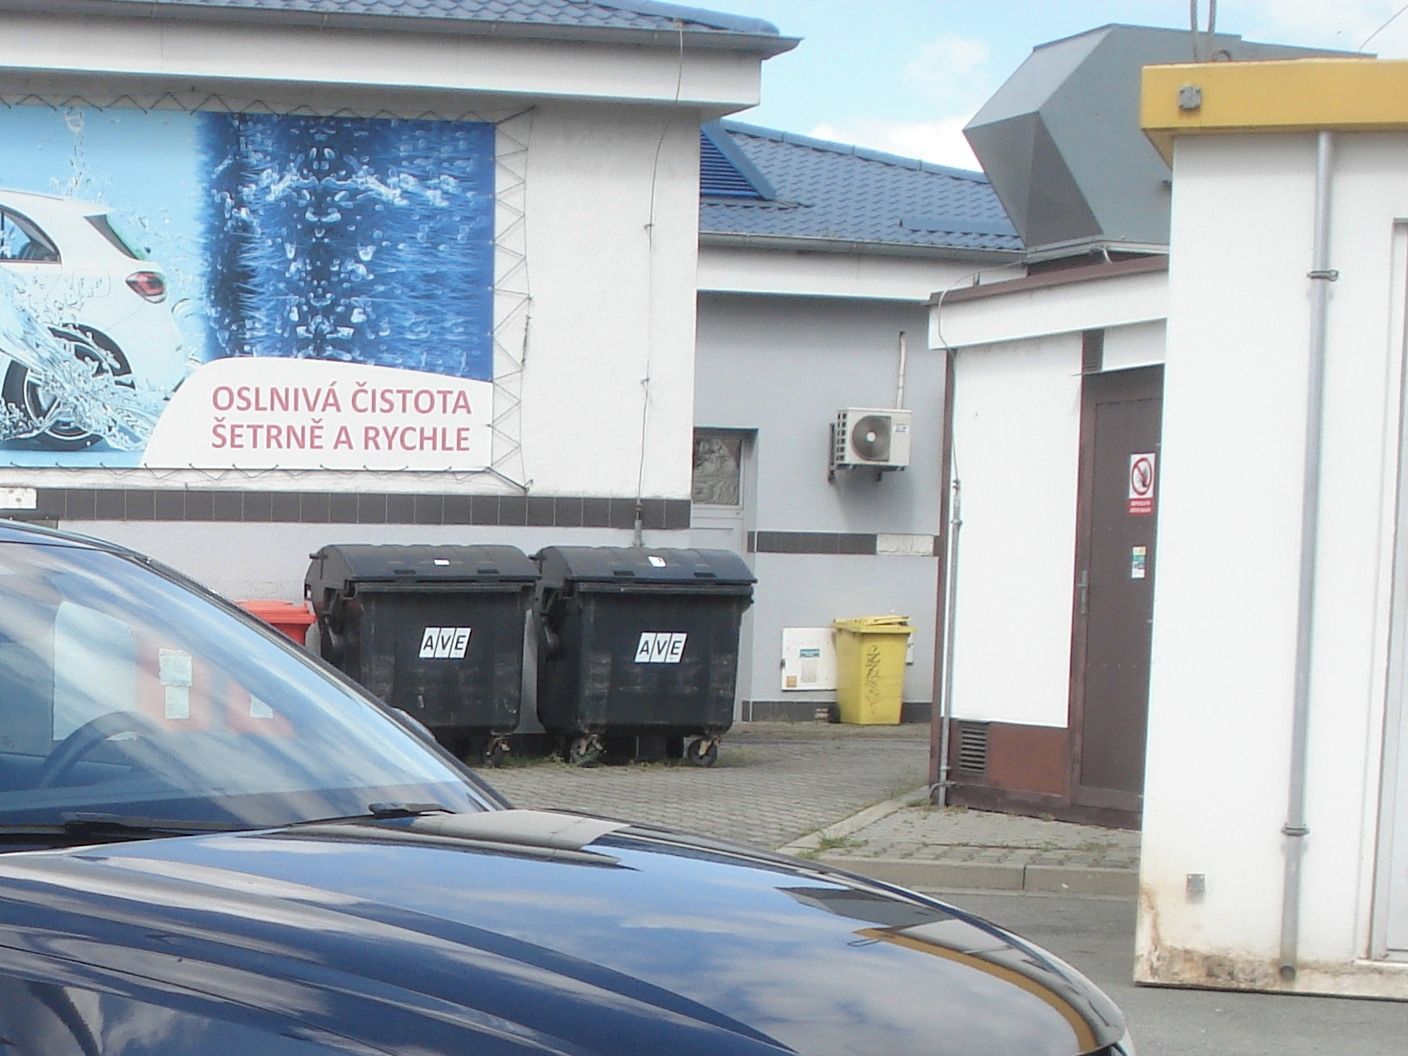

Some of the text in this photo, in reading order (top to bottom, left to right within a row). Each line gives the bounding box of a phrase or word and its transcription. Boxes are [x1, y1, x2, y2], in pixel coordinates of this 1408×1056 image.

[212, 381, 472, 415] OSLNIVÁ ČISTOTA
[211, 417, 471, 452] ŠETRNĚ A RYCHLE
[423, 634, 467, 651] AVE
[639, 639, 682, 656] AVE
